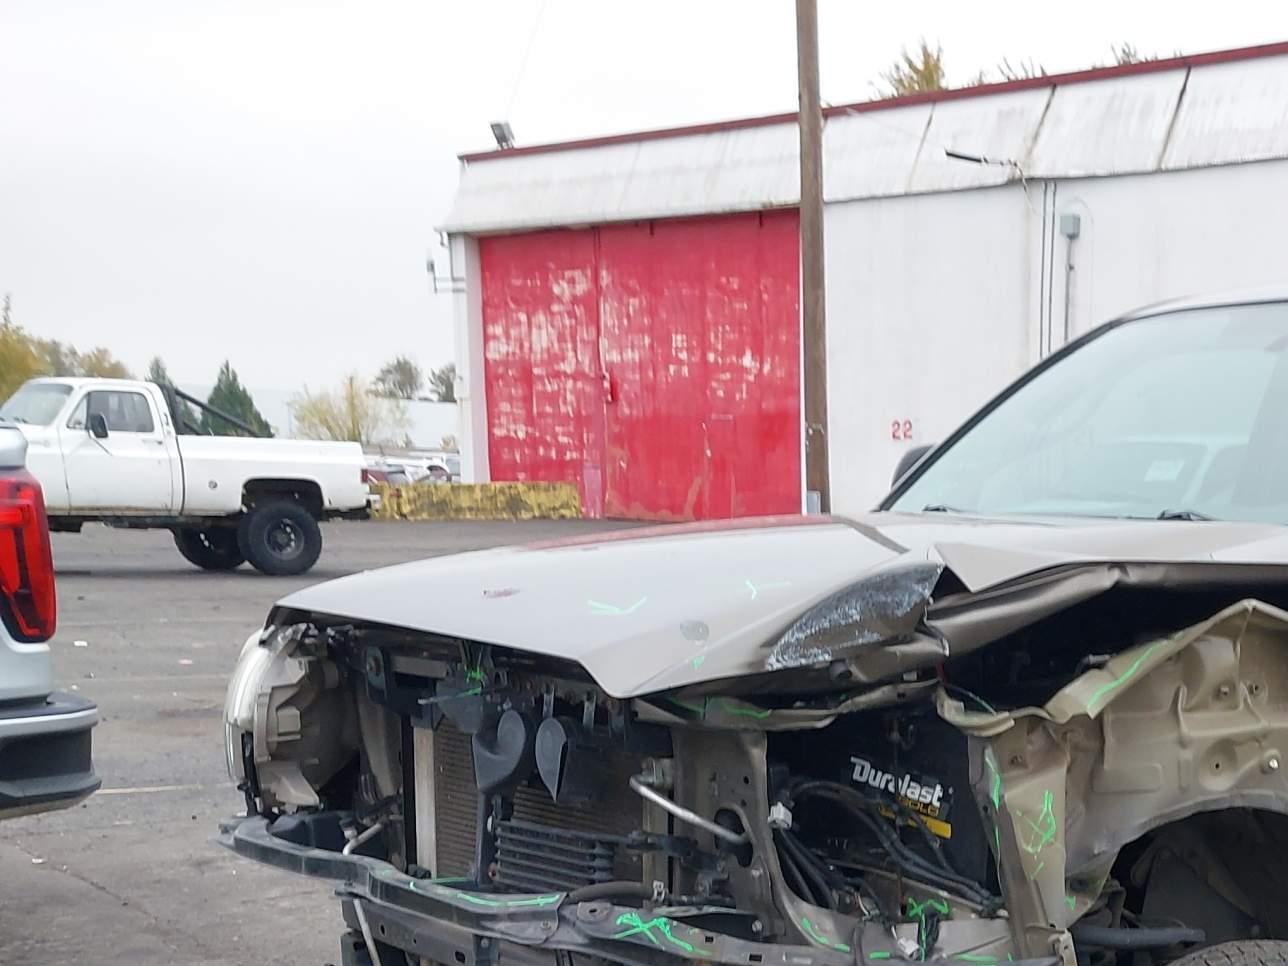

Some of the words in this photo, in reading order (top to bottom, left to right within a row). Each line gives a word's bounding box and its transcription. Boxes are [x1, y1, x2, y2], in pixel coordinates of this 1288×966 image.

[891, 419, 913, 441] 22
[850, 756, 944, 809] Duralast
[899, 796, 939, 817] OLD
